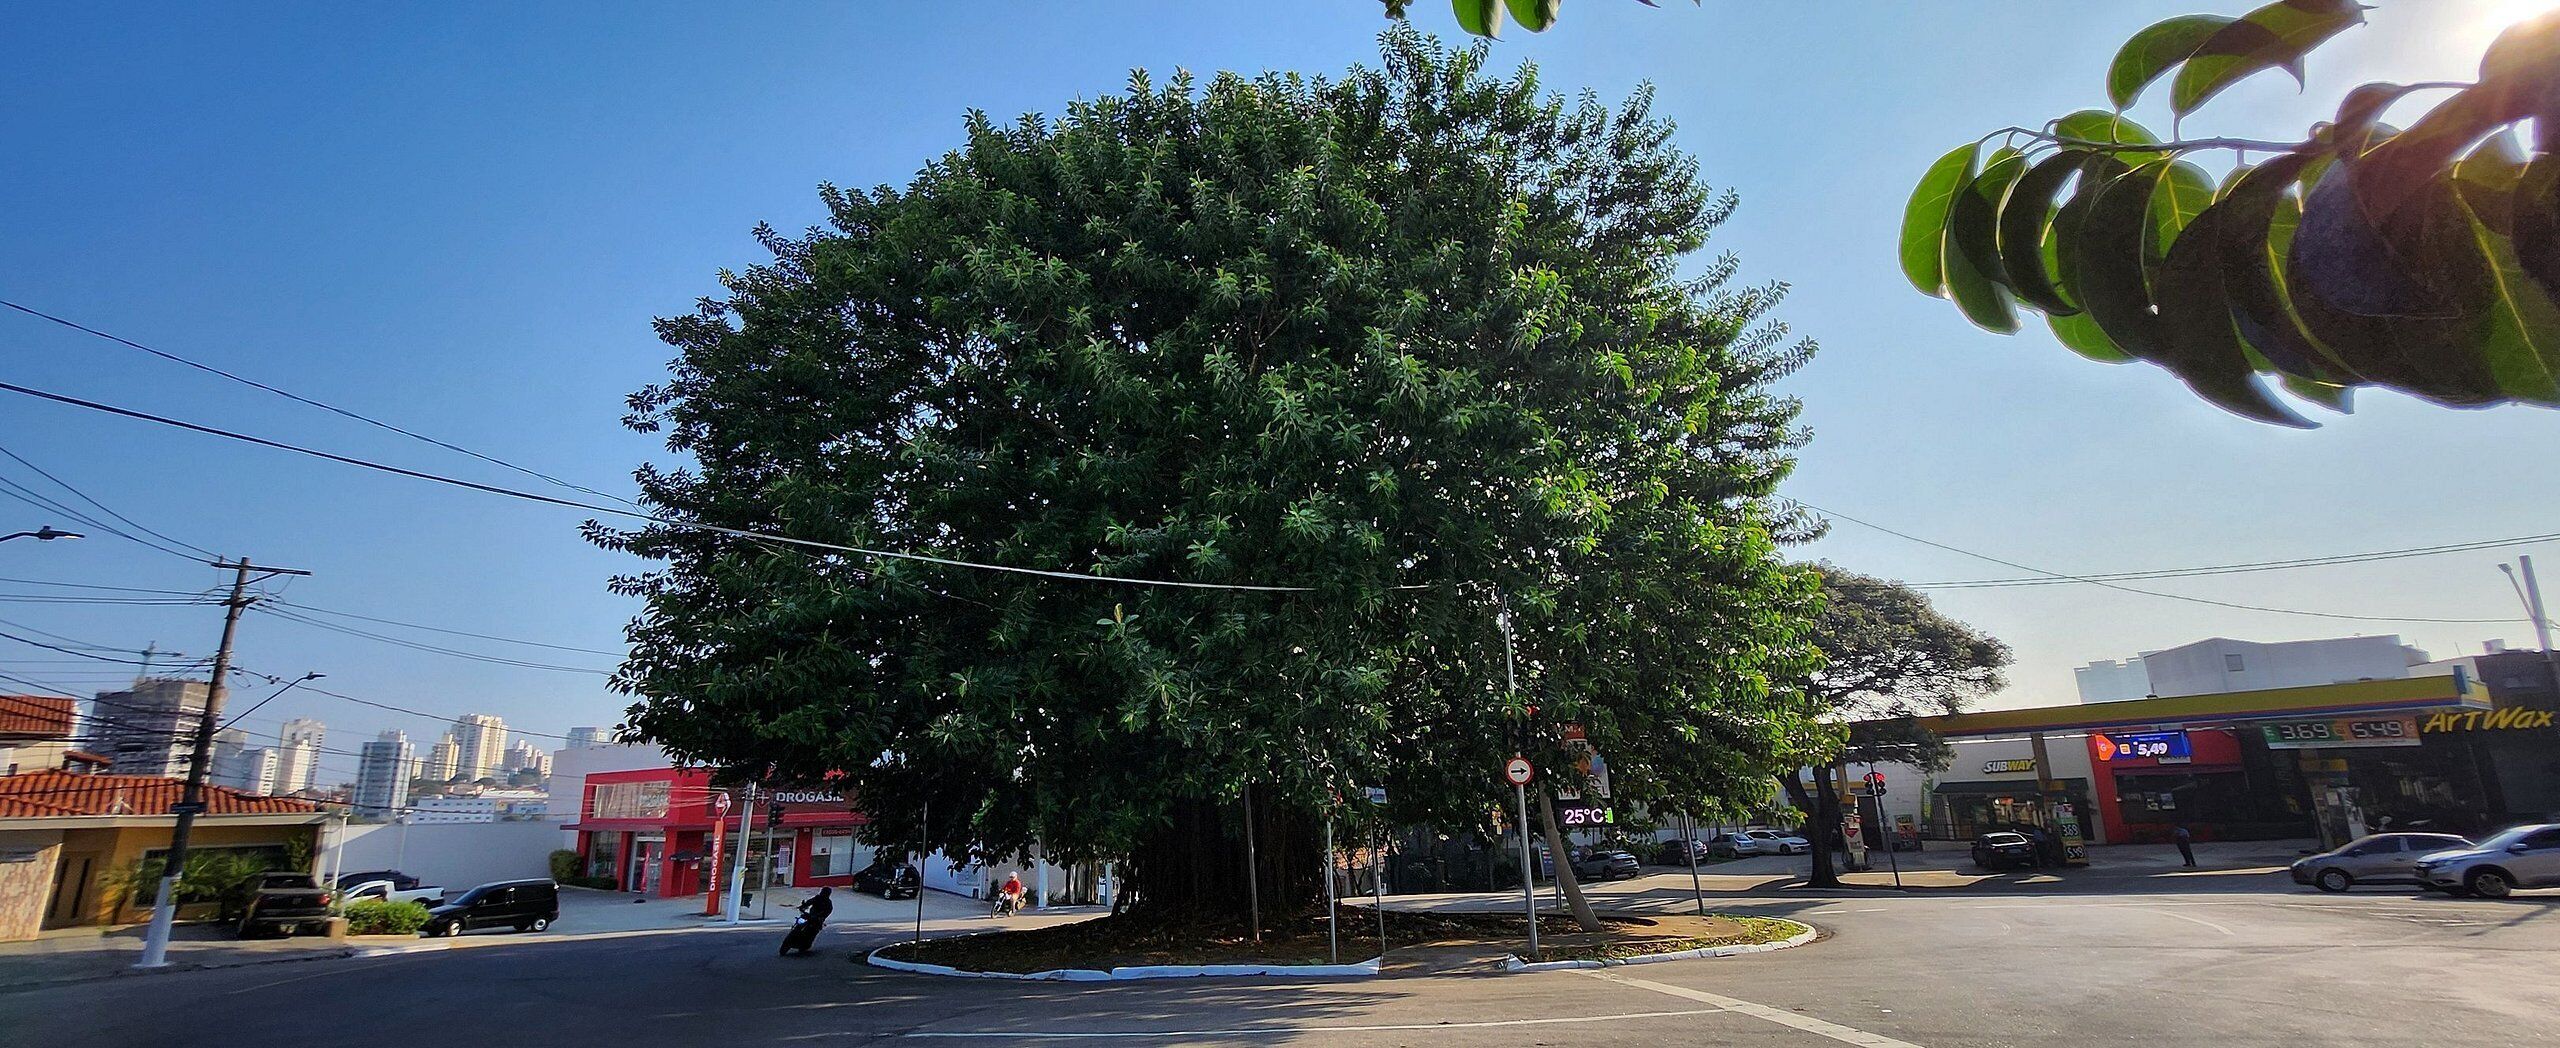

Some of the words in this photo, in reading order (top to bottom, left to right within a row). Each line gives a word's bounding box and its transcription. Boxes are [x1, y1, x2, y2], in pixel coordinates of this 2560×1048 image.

[2280, 723, 2331, 739] 3.69
[2351, 721, 2404, 738] 5.49
[2137, 742, 2168, 757] 5,49
[1983, 759, 2037, 773] SUBWAY
[1564, 807, 1604, 824] 25°C
[709, 835, 720, 891] DROGASIL
